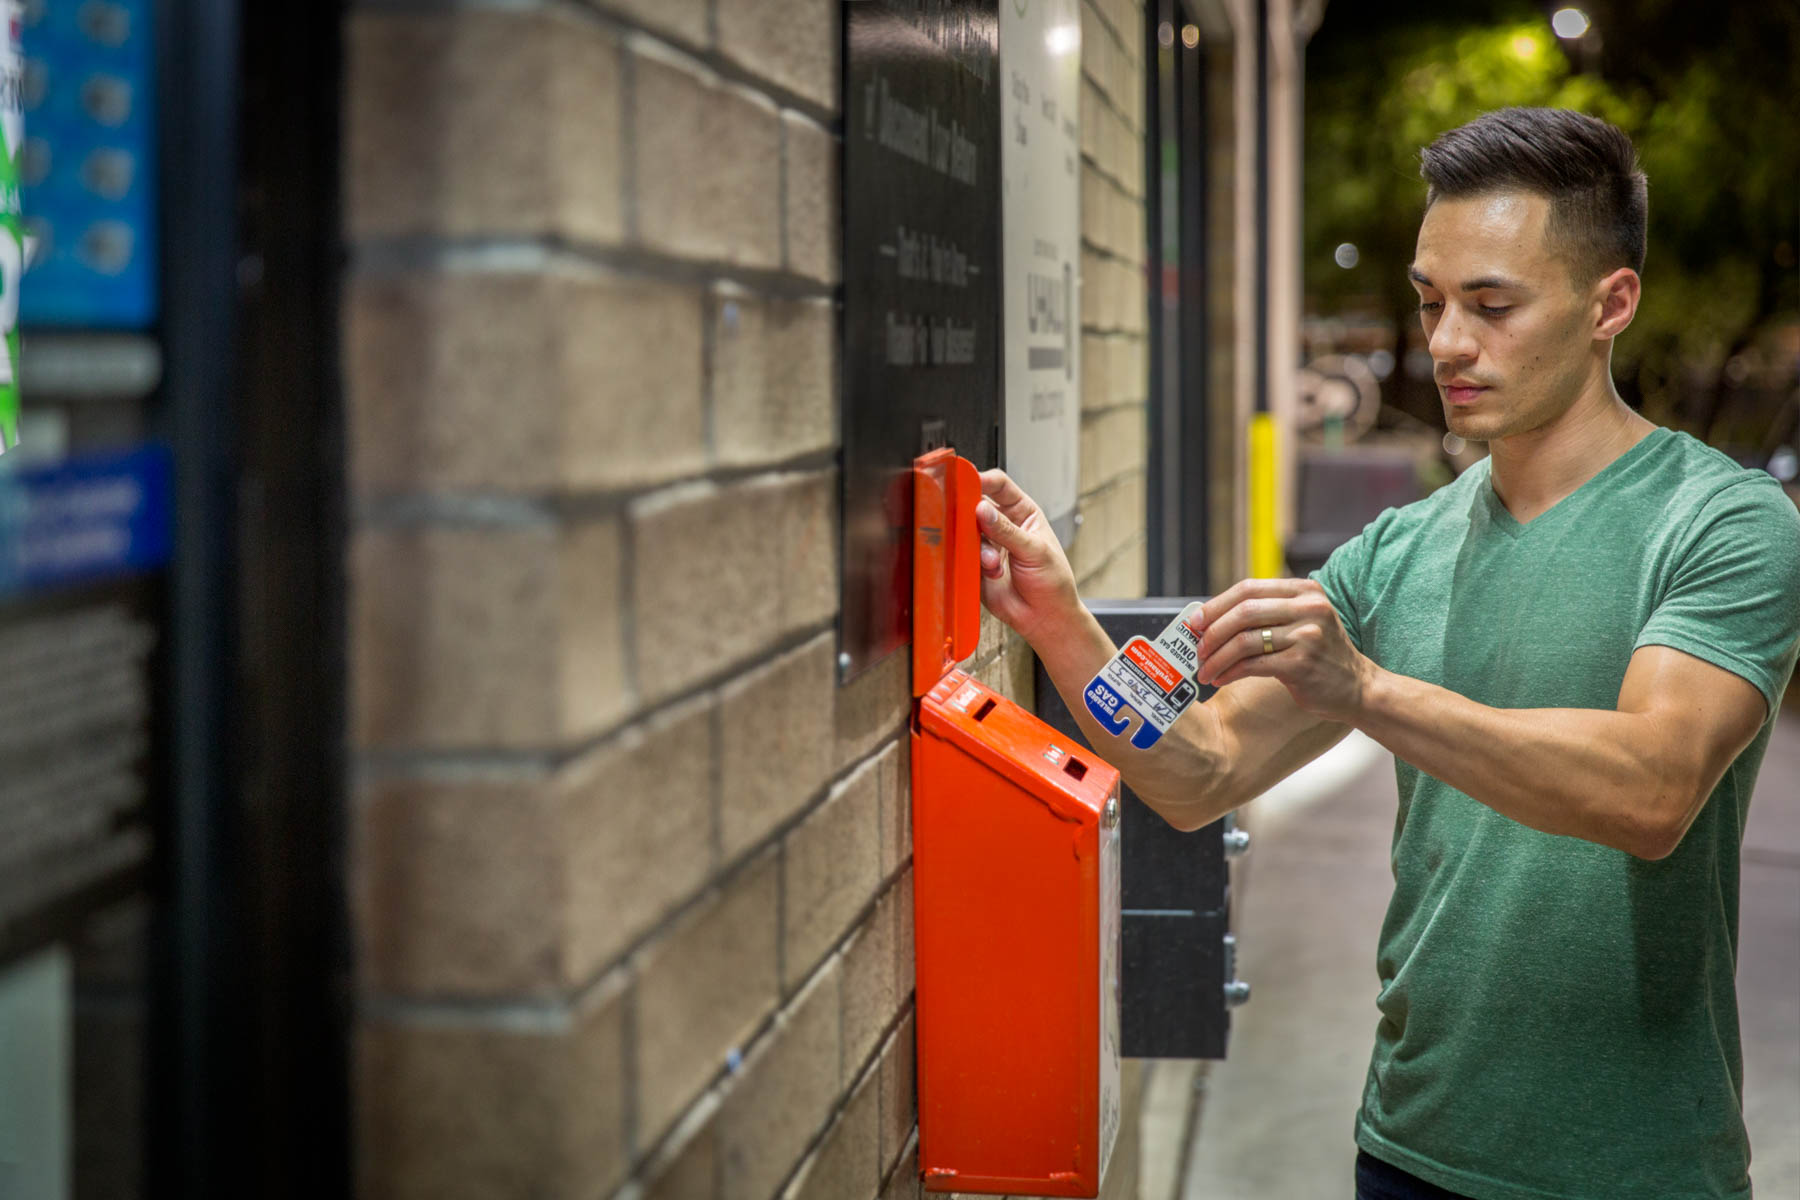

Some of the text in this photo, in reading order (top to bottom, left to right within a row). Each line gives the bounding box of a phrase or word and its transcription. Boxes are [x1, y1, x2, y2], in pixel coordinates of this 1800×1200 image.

[1159, 638, 1171, 650] GAS
[1178, 624, 1199, 645] HAUL
[1169, 647, 1195, 672] UNLEADED
[1170, 636, 1197, 662] ONLY
[1130, 644, 1175, 687] myuhaul.com
[1087, 689, 1115, 716] UNLEADED
[1093, 683, 1119, 708] GAS
[1150, 712, 1165, 726] MODEL
